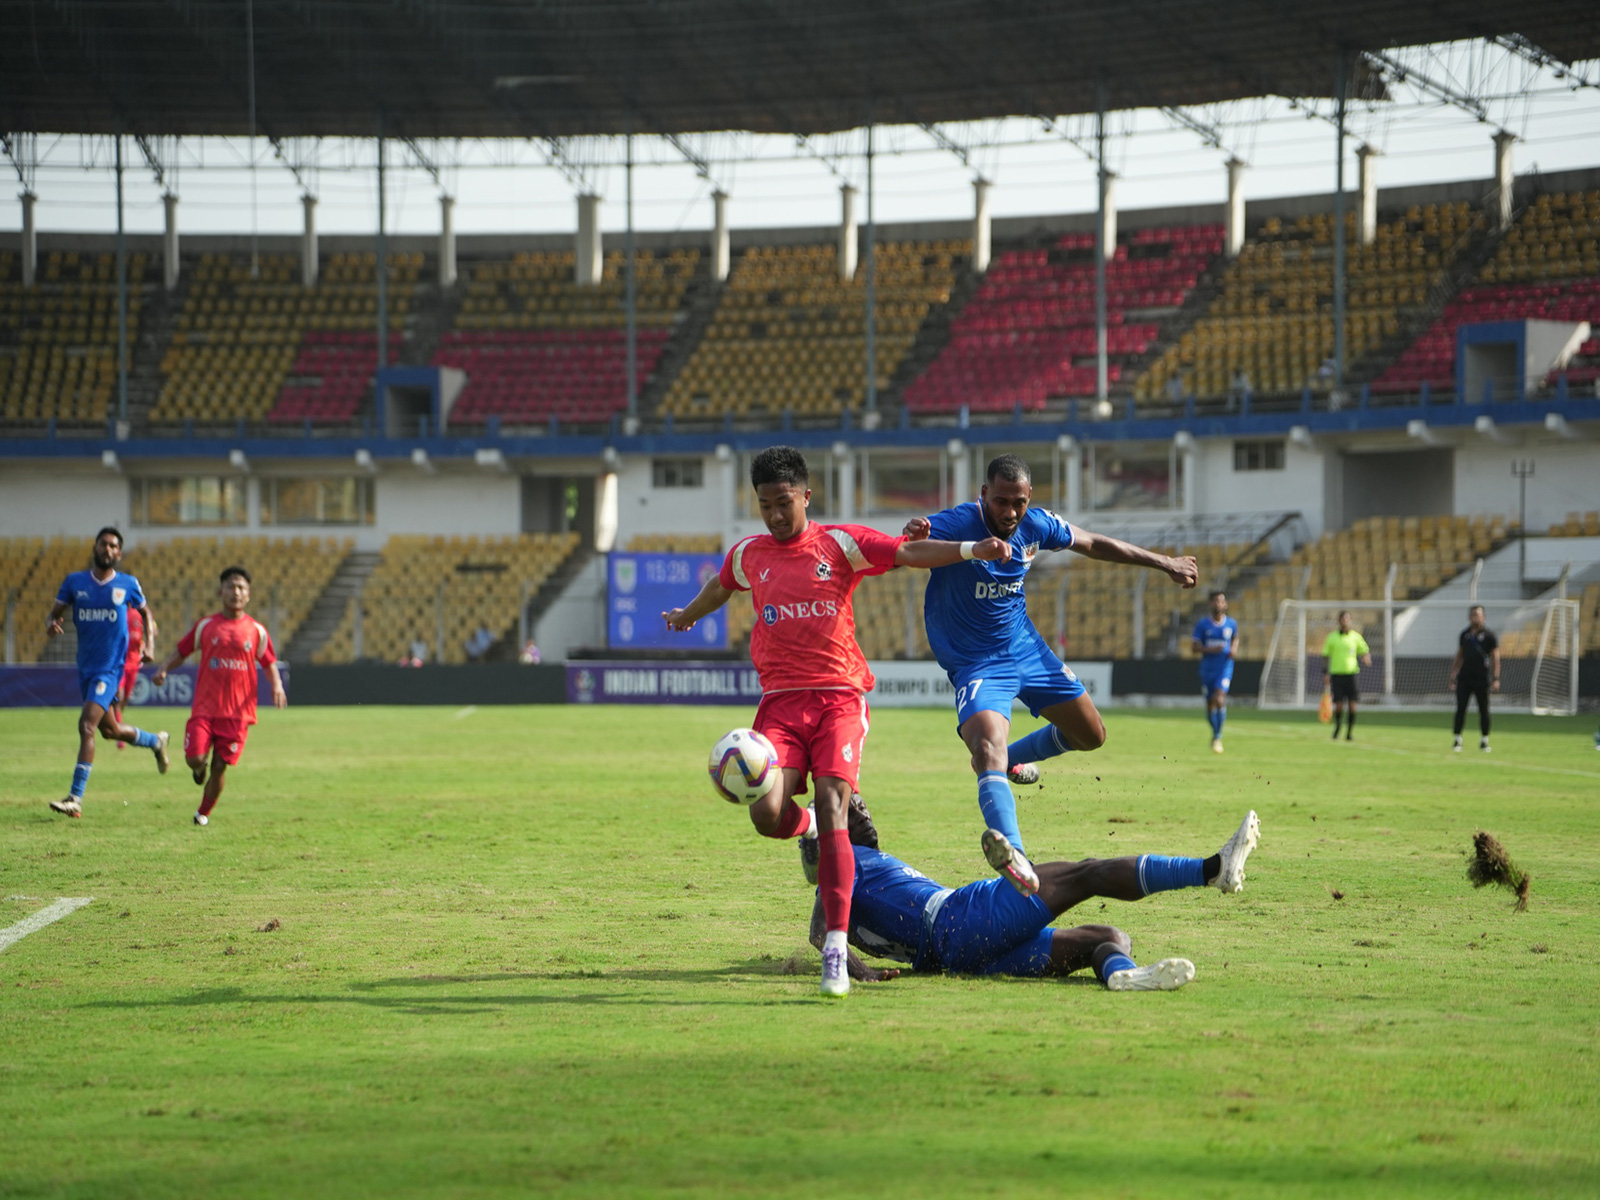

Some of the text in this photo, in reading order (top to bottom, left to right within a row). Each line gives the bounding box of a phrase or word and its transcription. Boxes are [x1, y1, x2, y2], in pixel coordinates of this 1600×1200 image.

[975, 577, 1024, 600] DEMP
[78, 607, 118, 623] DEMPO
[779, 600, 838, 621] NECS
[603, 669, 659, 696] INDIAN
[660, 669, 739, 696] FOOTBALL
[876, 677, 930, 696] DEMPO
[957, 678, 984, 715] 27
